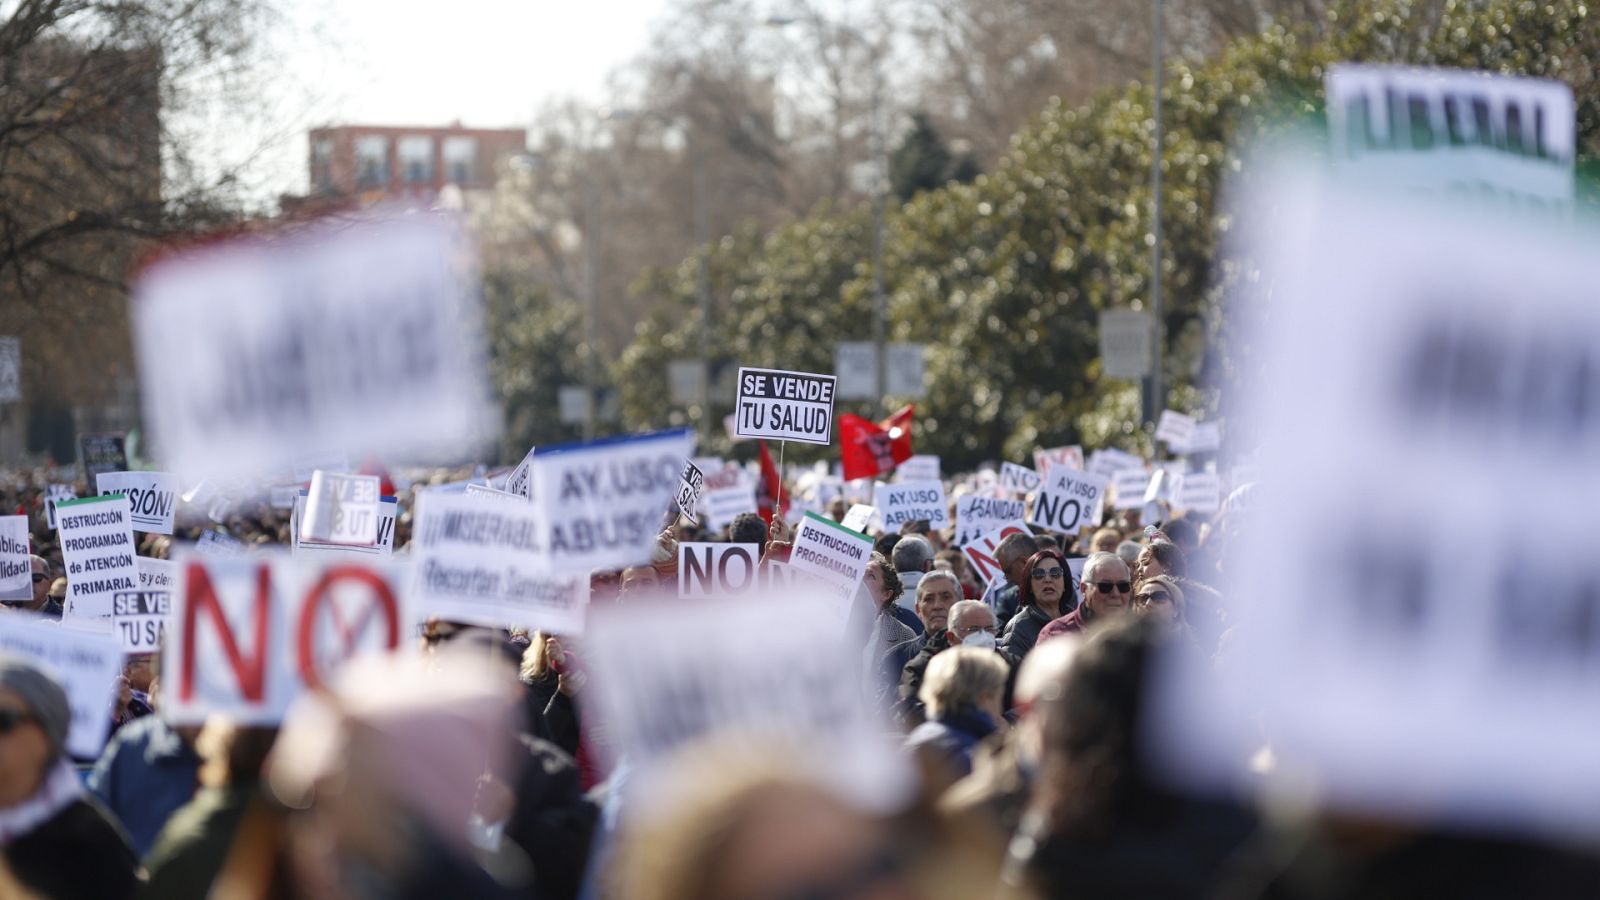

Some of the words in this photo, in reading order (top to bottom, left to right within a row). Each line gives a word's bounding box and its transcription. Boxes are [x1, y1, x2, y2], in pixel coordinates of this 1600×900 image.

[743, 374, 767, 396] SE
[772, 376, 833, 402] VENDE
[742, 402, 766, 430] TU
[770, 403, 828, 434] SALUD
[1004, 466, 1041, 490] NO
[1057, 476, 1097, 499] AY,USO
[888, 489, 940, 507] AY,USO
[1034, 491, 1081, 530] NO
[62, 510, 123, 530] DESTRUCCIÓN
[65, 532, 129, 552] PROGRAMADA
[801, 525, 864, 561] DESTRUCCIÓN
[69, 561, 82, 575] de
[84, 554, 134, 573] ATENCIÓN
[682, 546, 754, 595] NO
[795, 545, 859, 581] PROGRAMADA
[72, 577, 136, 597] PRIMARIA.
[114, 593, 140, 615] SE
[119, 621, 140, 647] TU
[180, 562, 399, 704] NO
